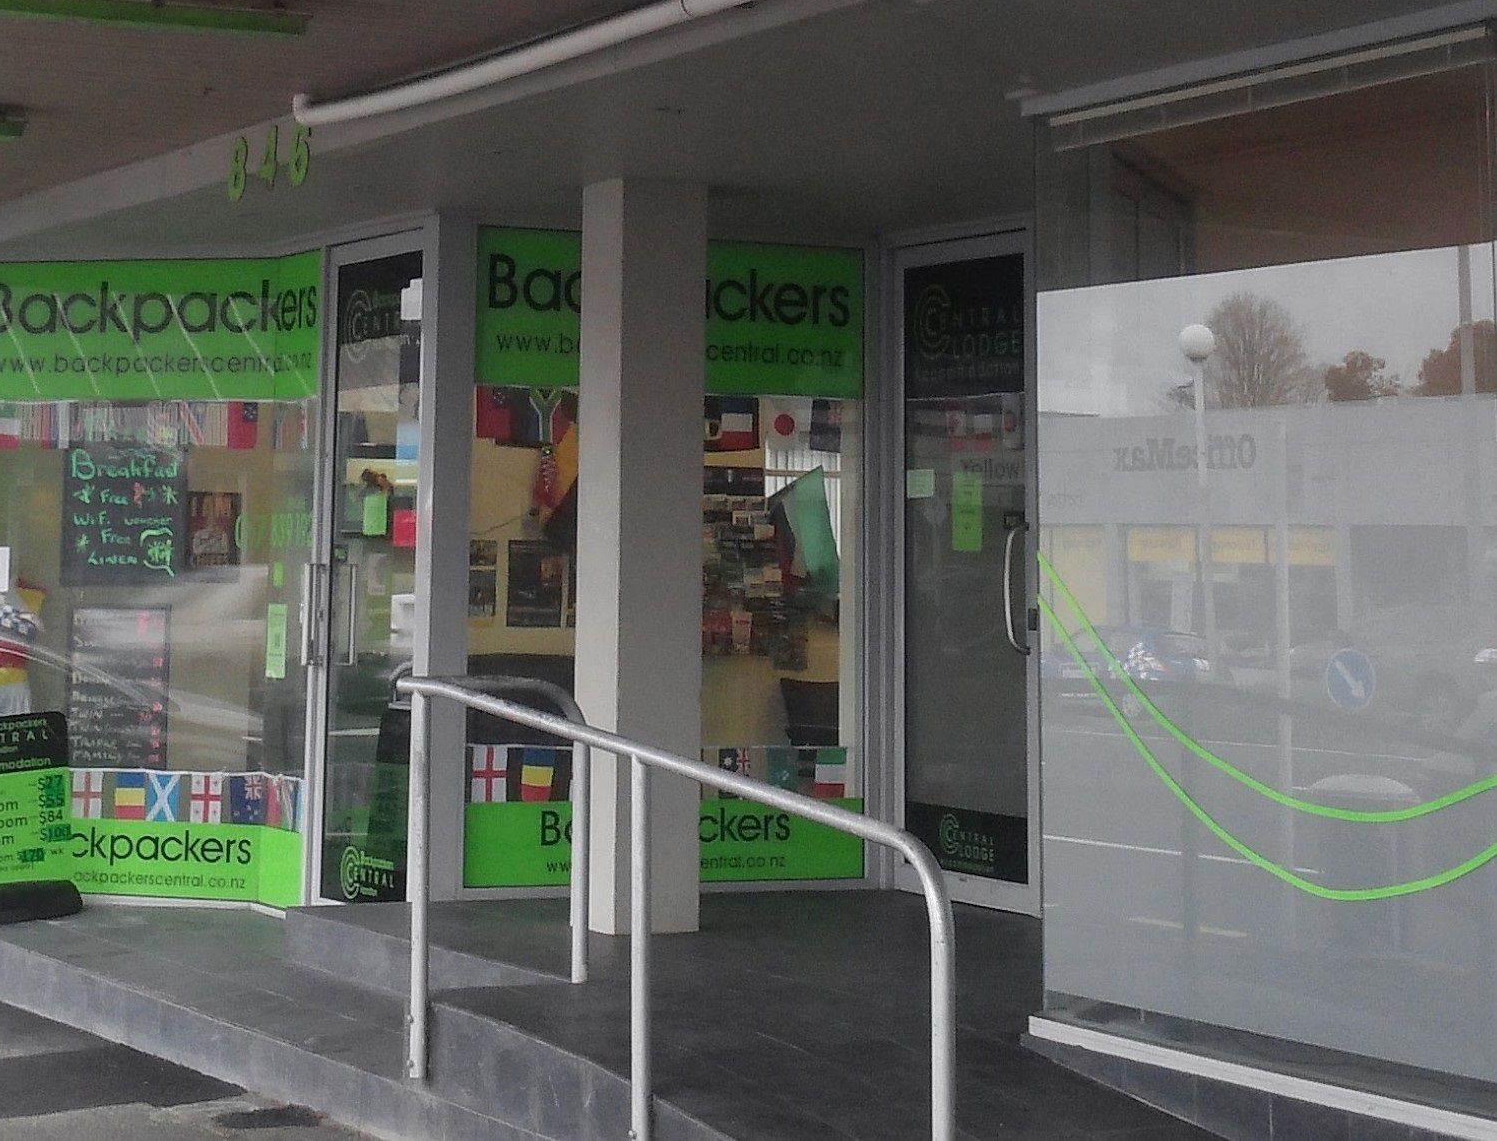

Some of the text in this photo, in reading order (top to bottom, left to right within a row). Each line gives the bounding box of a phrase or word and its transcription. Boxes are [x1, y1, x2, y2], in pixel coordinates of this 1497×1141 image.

[228, 124, 311, 201] 846
[39, 808, 63, 825] $84
[72, 826, 251, 867] ckpackers
